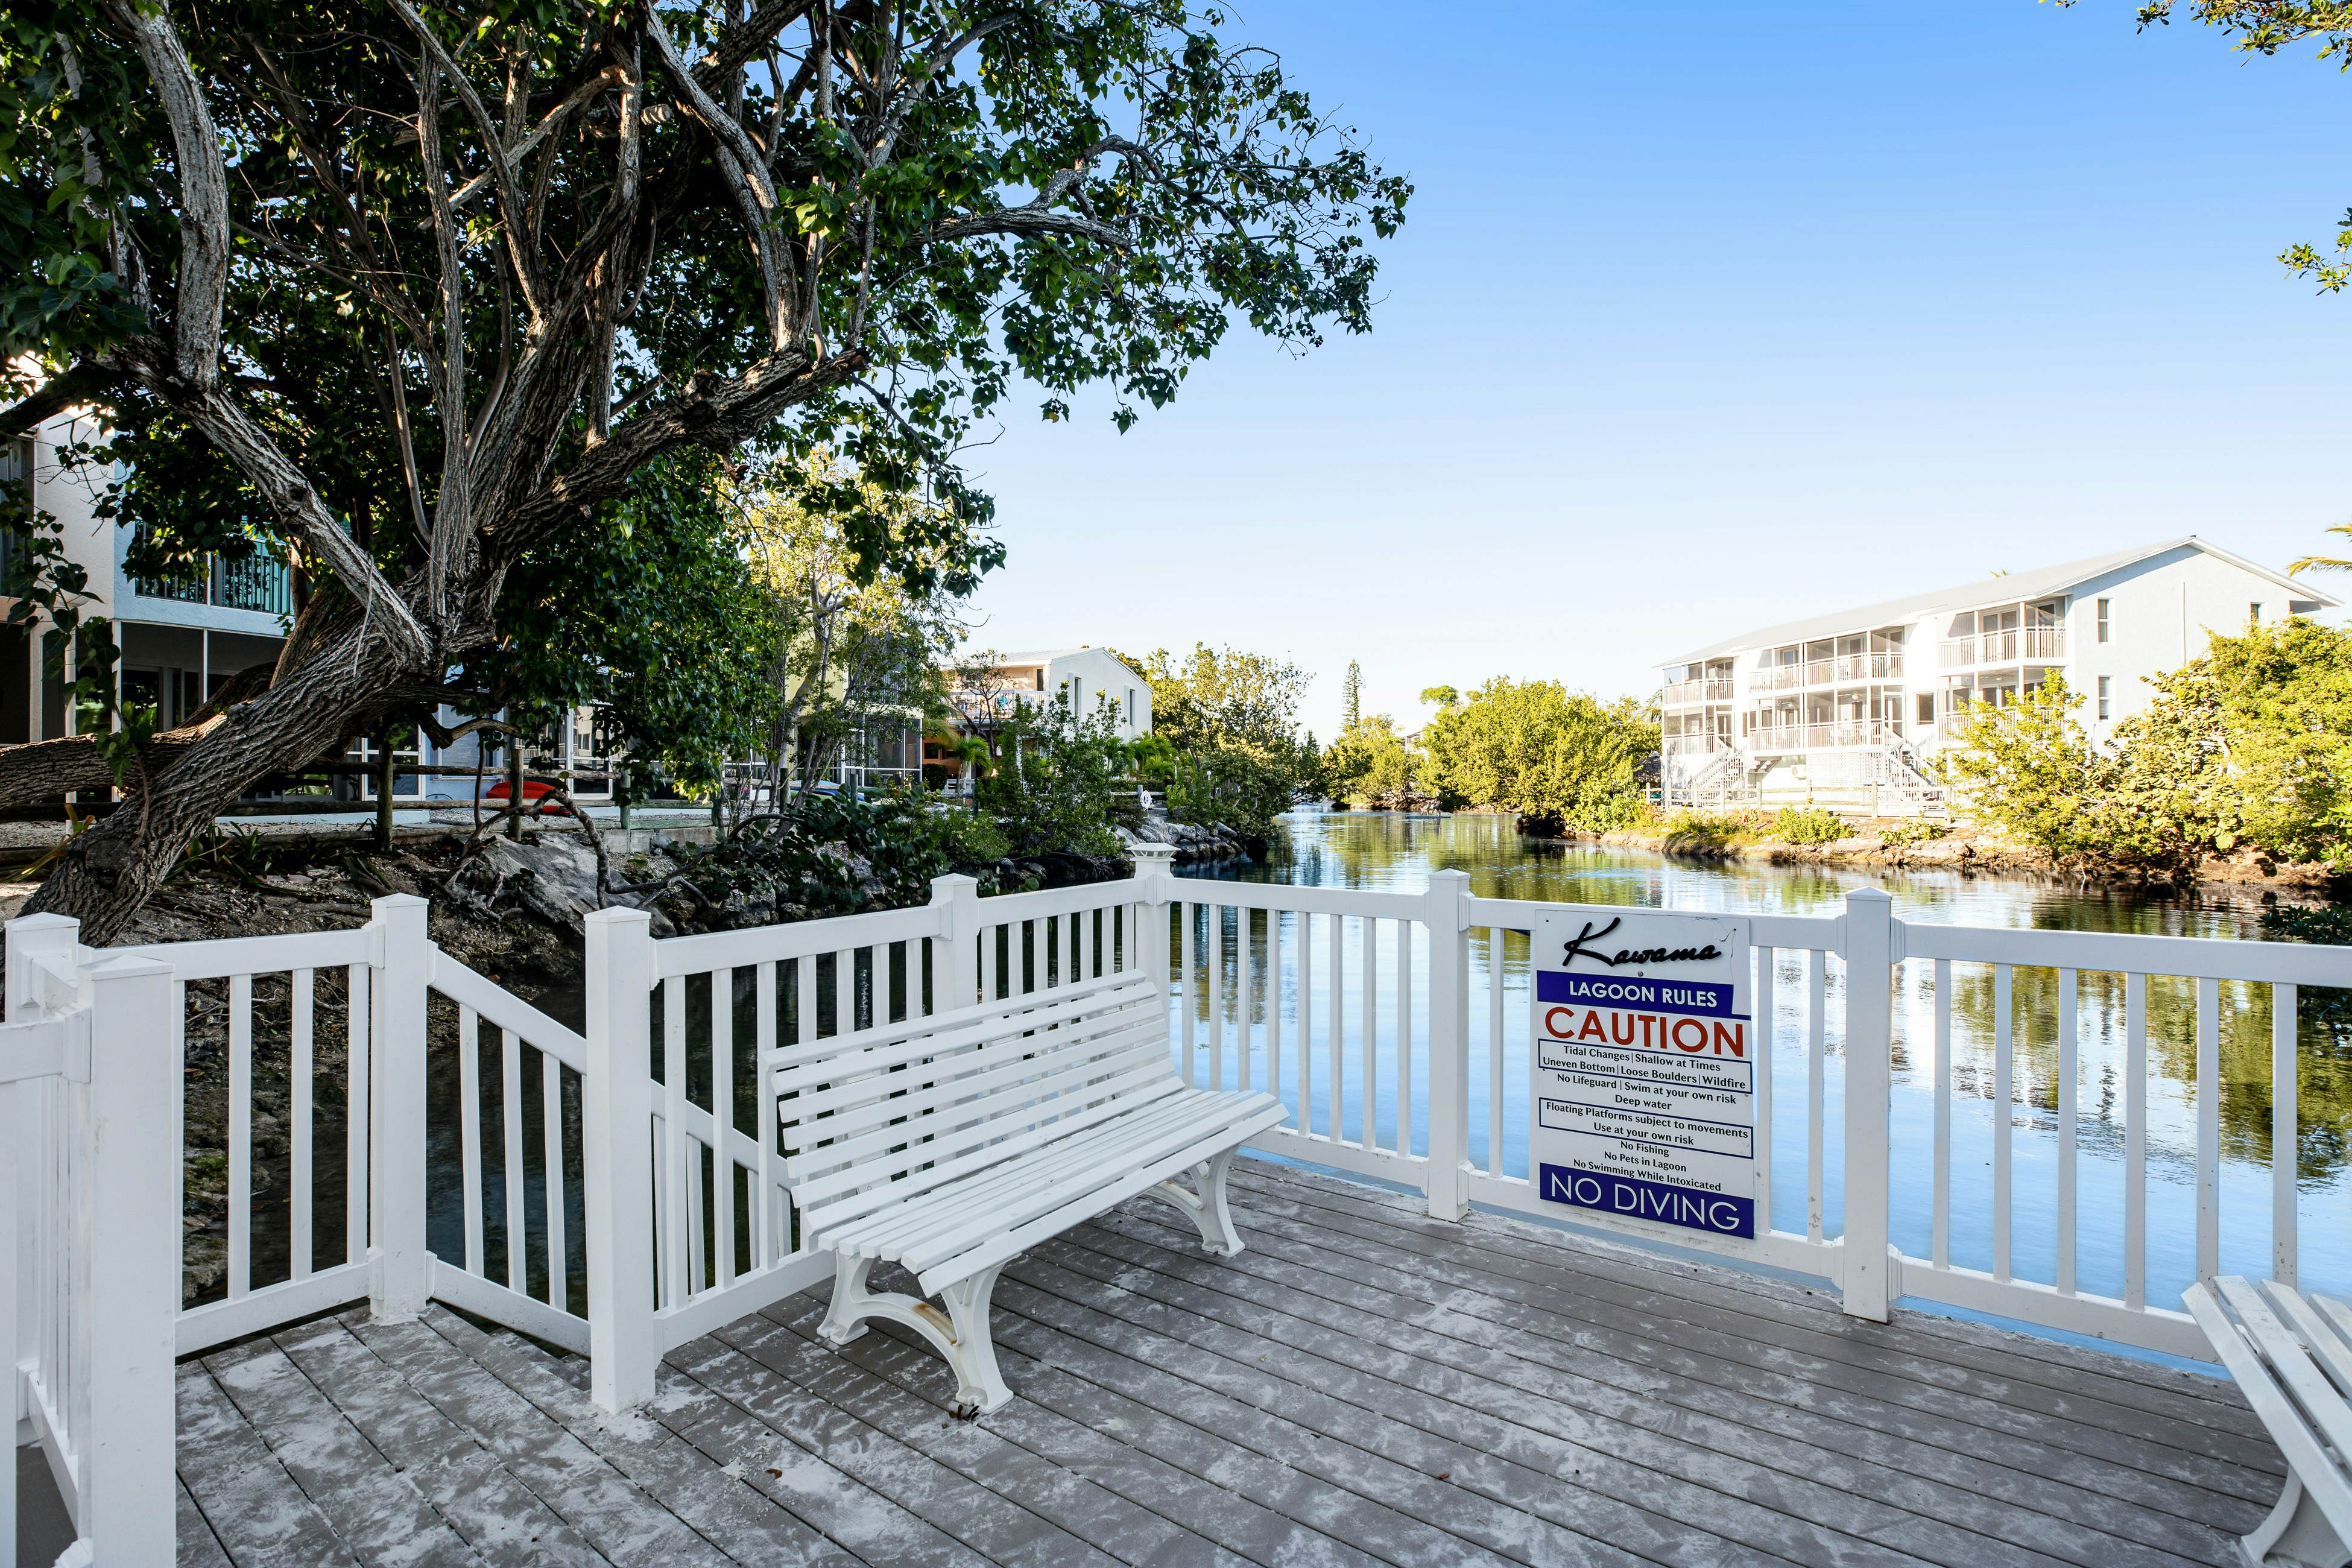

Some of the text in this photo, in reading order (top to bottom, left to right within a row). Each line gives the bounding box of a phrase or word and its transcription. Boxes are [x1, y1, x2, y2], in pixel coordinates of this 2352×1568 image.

[1562, 917, 1722, 967] Kawama
[1569, 981, 1717, 1008] LAGOON RULES
[1545, 1007, 1743, 1057] CAUTION
[1543, 1057, 1746, 1089] Uneven Bottom Loose Boulders Wildfire
[1563, 1046, 1586, 1056] Tidal
[1589, 1049, 1630, 1062] Changes
[1635, 1054, 1674, 1066] Shallow
[1689, 1060, 1721, 1071] Times
[1557, 1073, 1736, 1104] No Lifeguard Swim at your own risk
[1615, 1095, 1672, 1110] Deep water
[1546, 1102, 1748, 1139] Floating Platforms subject to movements
[1594, 1122, 1611, 1132] Use
[1626, 1129, 1649, 1139] your
[1675, 1134, 1694, 1145] risk
[1604, 1151, 1617, 1160] No
[1620, 1154, 1639, 1165] Pets
[1653, 1160, 1686, 1172] Lagoon
[1620, 1140, 1669, 1157] No Fishing
[1573, 1159, 1721, 1191] No Swimming While Intoxicated
[1552, 1172, 1739, 1230] NO DIVING
